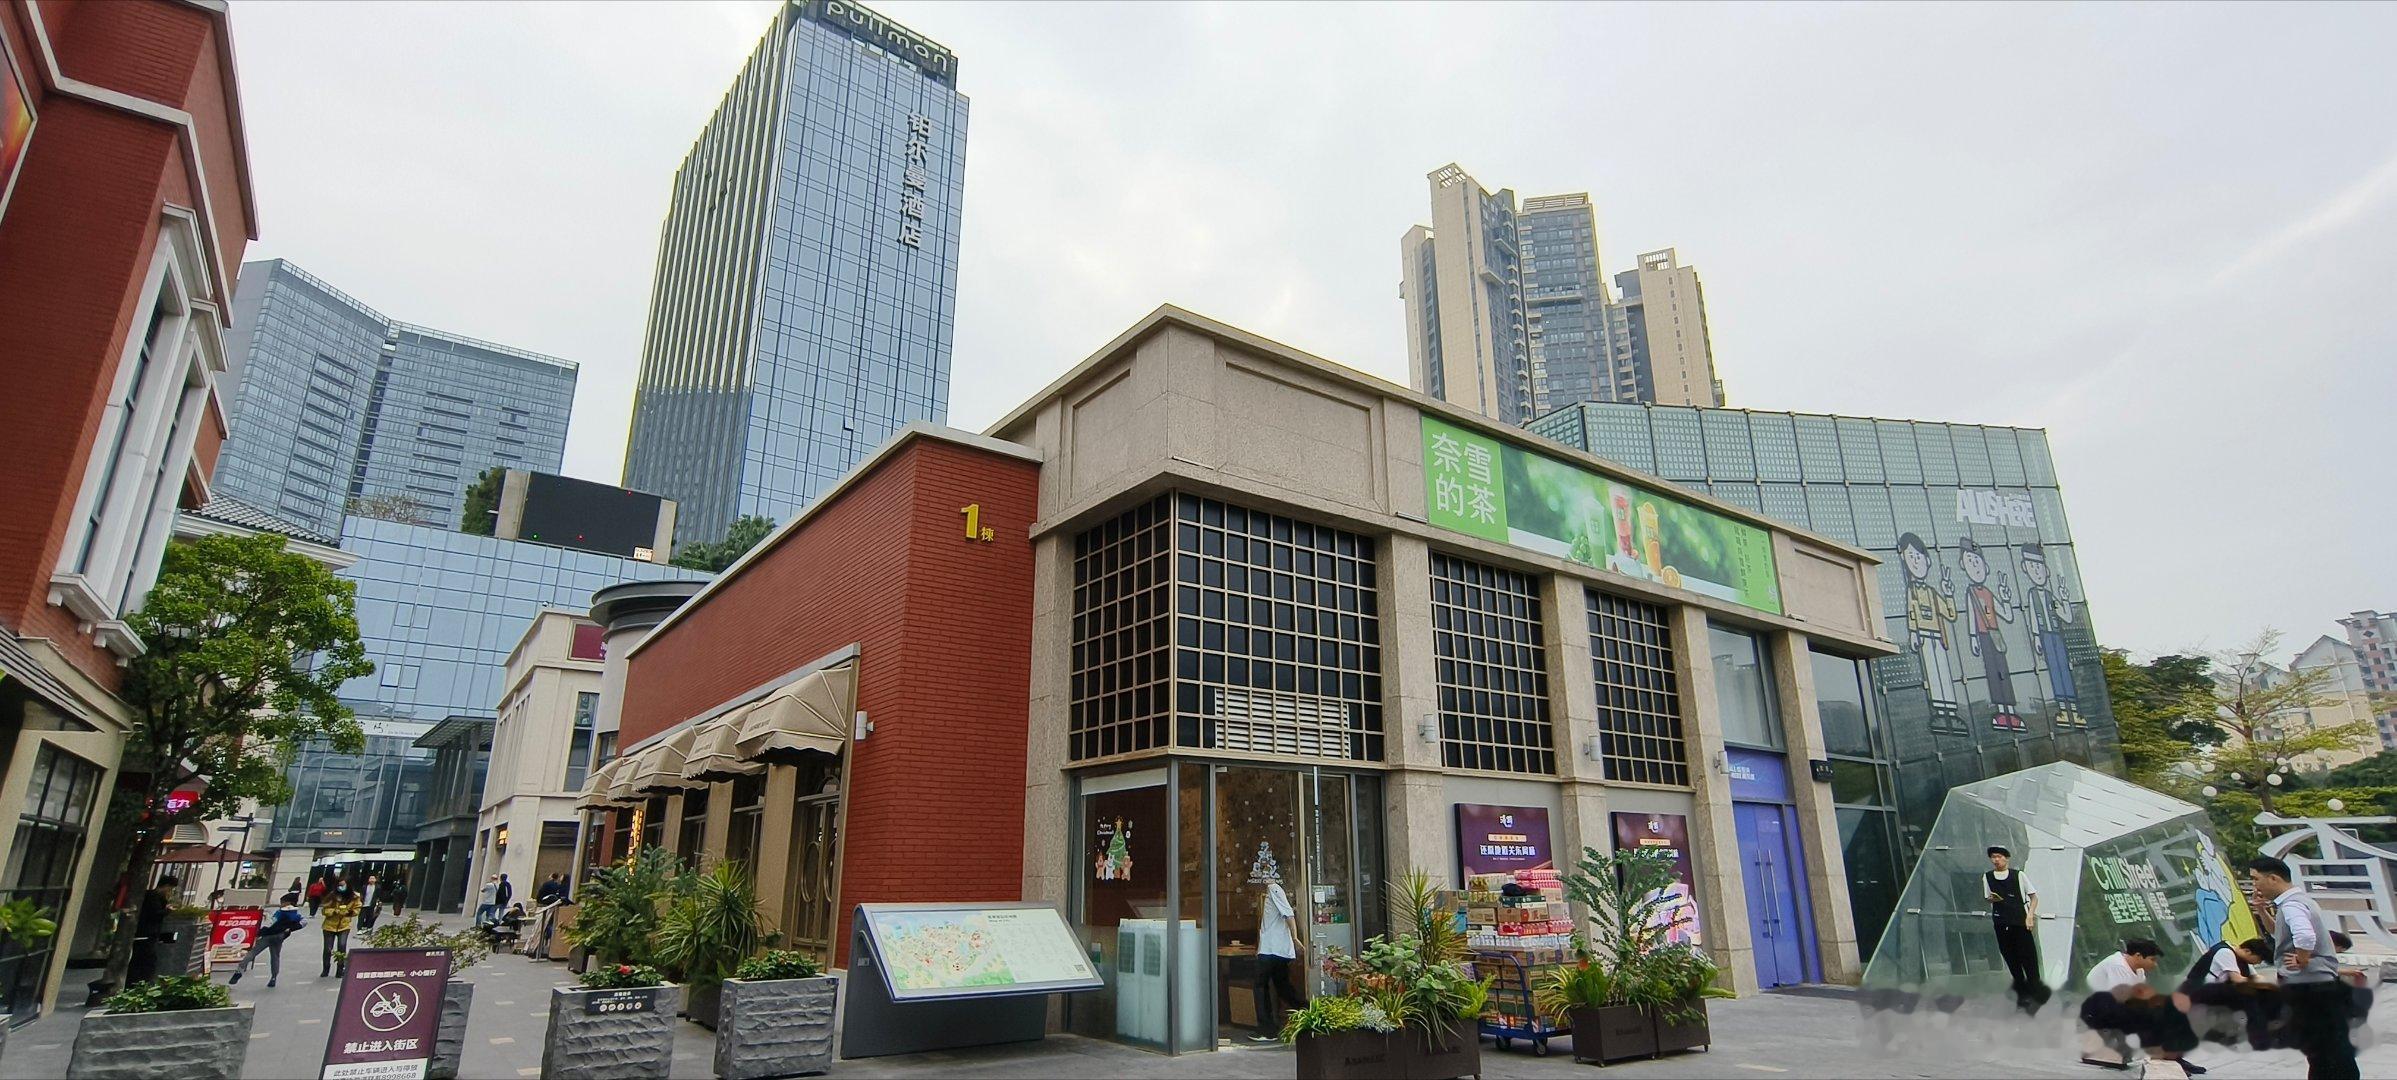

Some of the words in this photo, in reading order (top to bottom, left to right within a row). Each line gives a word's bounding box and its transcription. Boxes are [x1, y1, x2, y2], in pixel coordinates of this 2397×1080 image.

[826, 1, 947, 72] pullman
[900, 110, 932, 249] 铂尔曼酒店
[343, 1038, 419, 1054] 禁止进入街区
